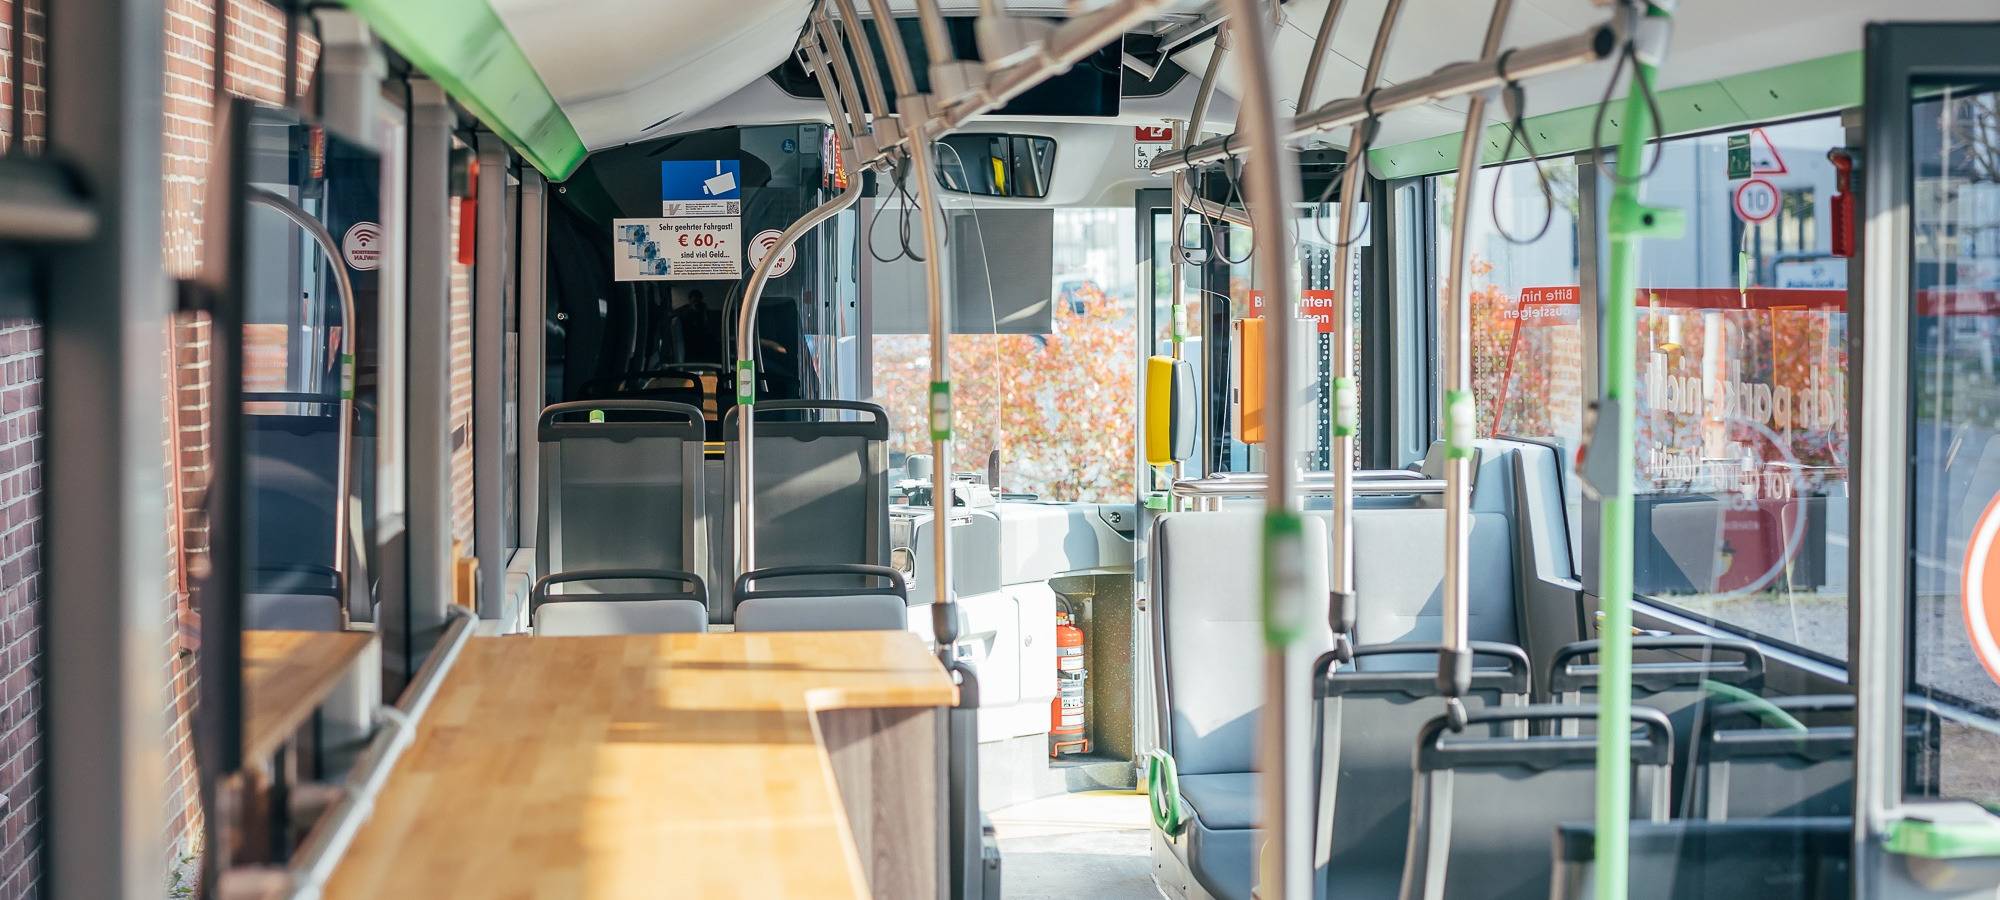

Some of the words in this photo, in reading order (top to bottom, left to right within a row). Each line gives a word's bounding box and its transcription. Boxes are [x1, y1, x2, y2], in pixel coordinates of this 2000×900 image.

[1137, 159, 1149, 168] 32
[1747, 190, 1770, 211] 10
[674, 223, 702, 232] geehrter
[703, 222, 733, 232] Fahrgast!
[678, 234, 689, 247] €
[693, 233, 725, 249] 60,-
[680, 250, 695, 258] sind
[695, 250, 708, 258] viel
